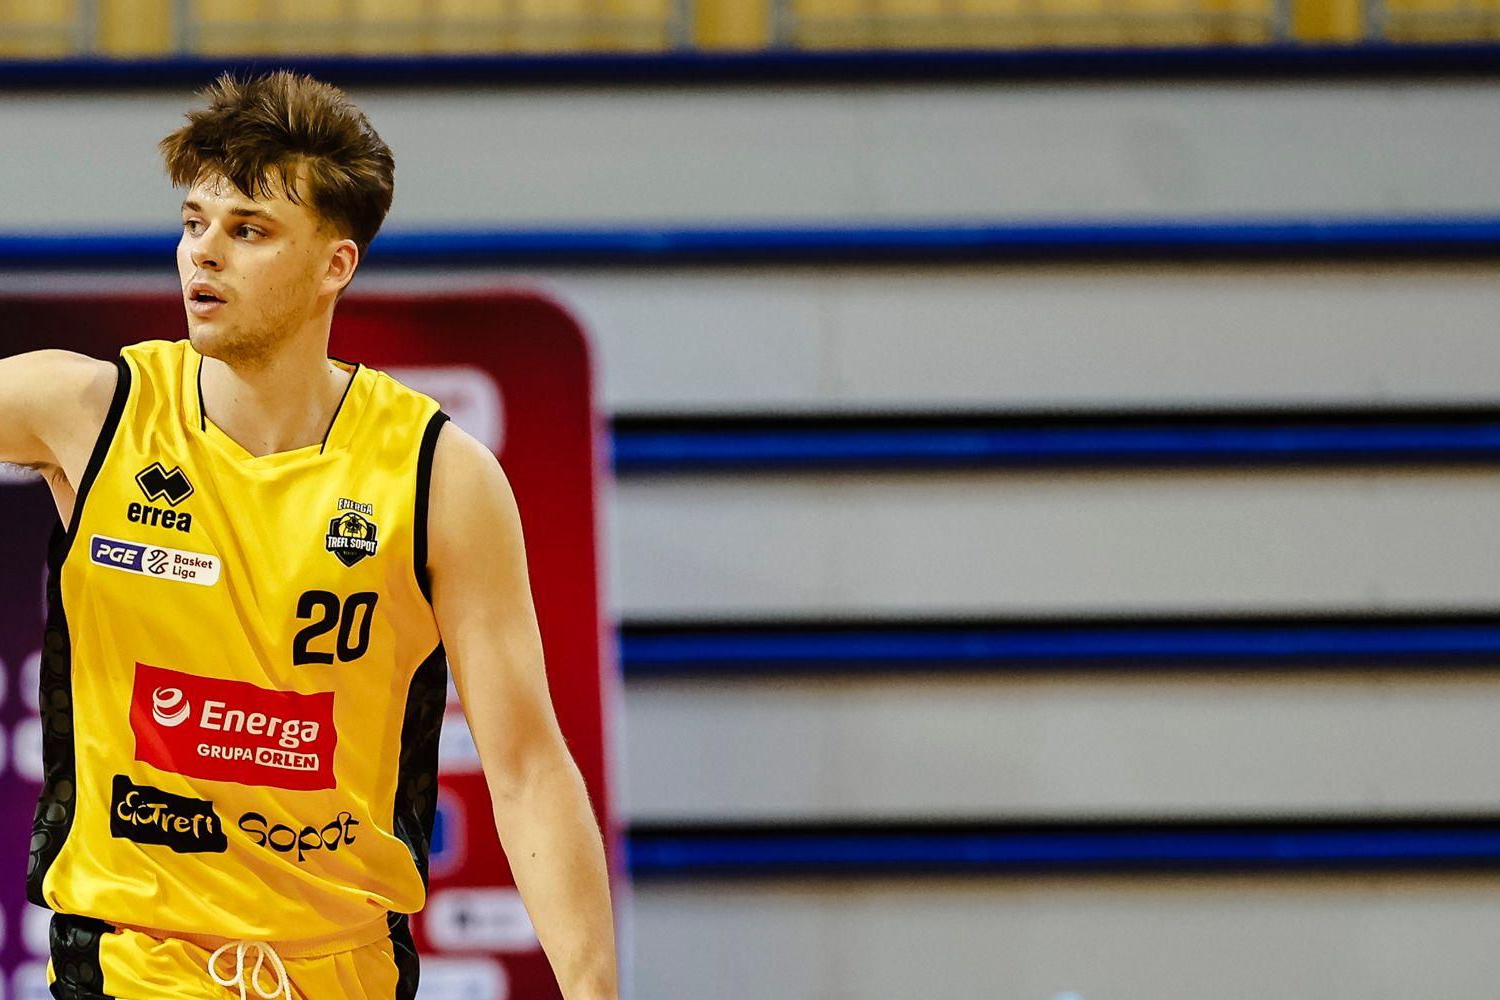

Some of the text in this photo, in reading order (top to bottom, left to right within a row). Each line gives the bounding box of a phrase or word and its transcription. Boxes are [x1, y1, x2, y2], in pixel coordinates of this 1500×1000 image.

[127, 502, 192, 533] errea
[338, 498, 373, 516] ENERGA
[96, 543, 139, 566] PGE
[327, 536, 349, 549] TREFL
[350, 538, 377, 554] SOPOT
[172, 567, 197, 580] Liga
[174, 554, 213, 570] Basket
[292, 589, 379, 667] 20
[199, 699, 320, 749] Energa
[196, 743, 318, 770] GRUPA ORLEN
[237, 810, 360, 863] Sopot
